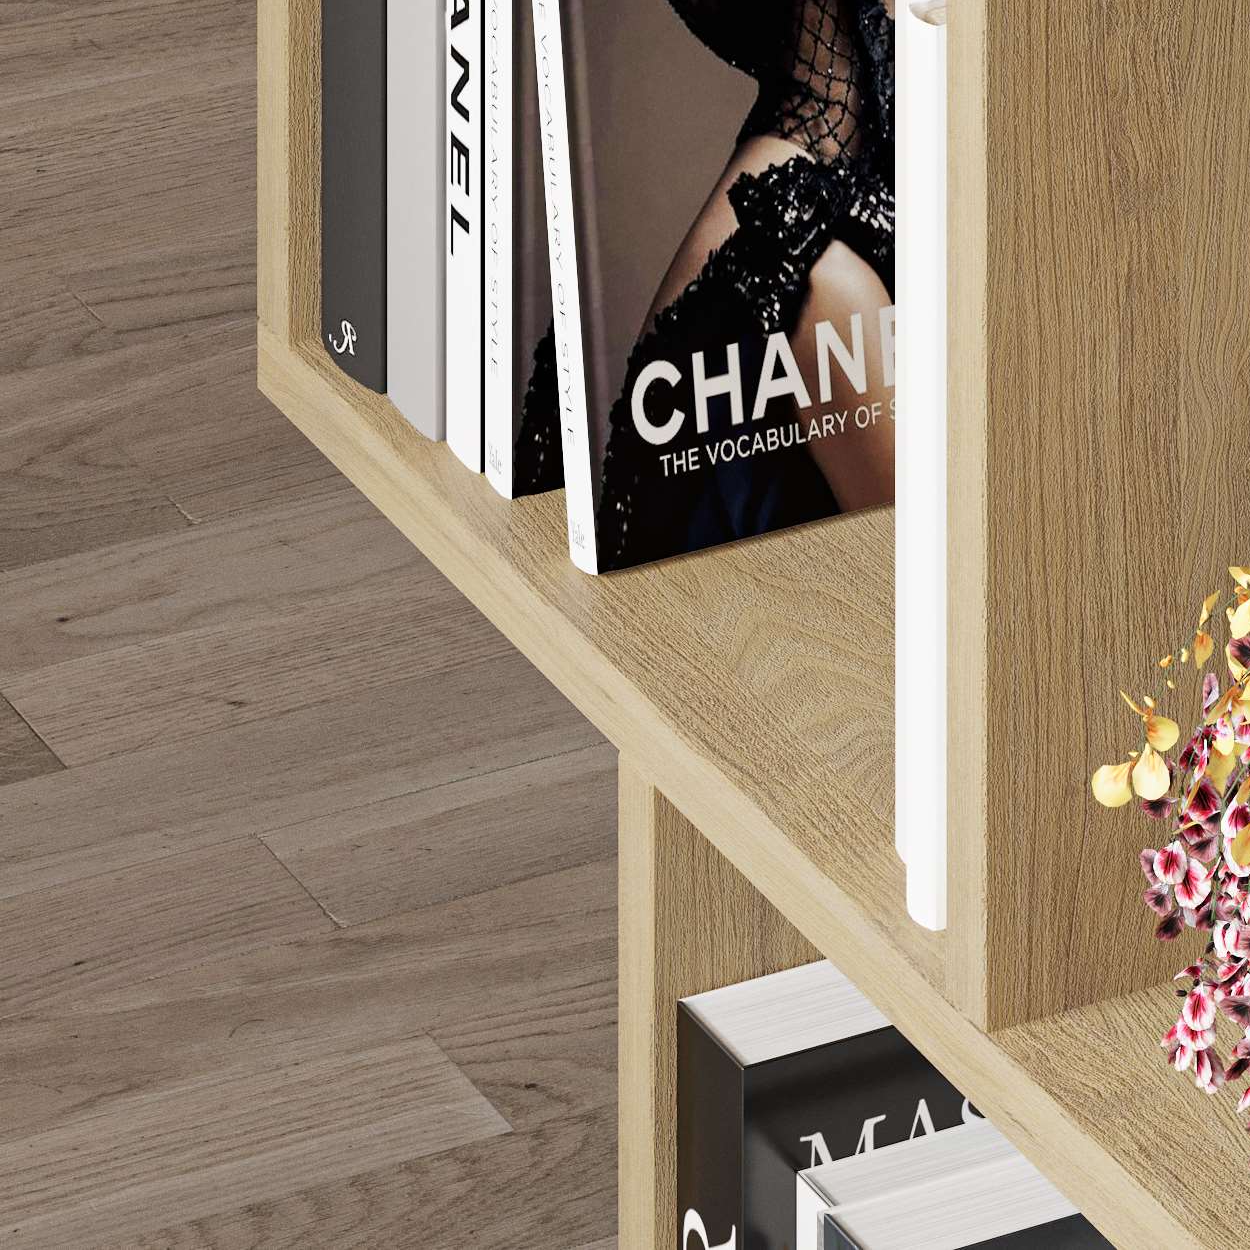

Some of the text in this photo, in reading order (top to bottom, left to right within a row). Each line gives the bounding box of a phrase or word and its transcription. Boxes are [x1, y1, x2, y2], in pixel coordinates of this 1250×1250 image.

[539, 33, 563, 268] VOCABULARY
[555, 281, 568, 328] OF
[561, 342, 576, 446] STYLE
[659, 447, 701, 477] THE
[705, 410, 849, 466] VOCABULARY
[854, 402, 883, 429] OF
